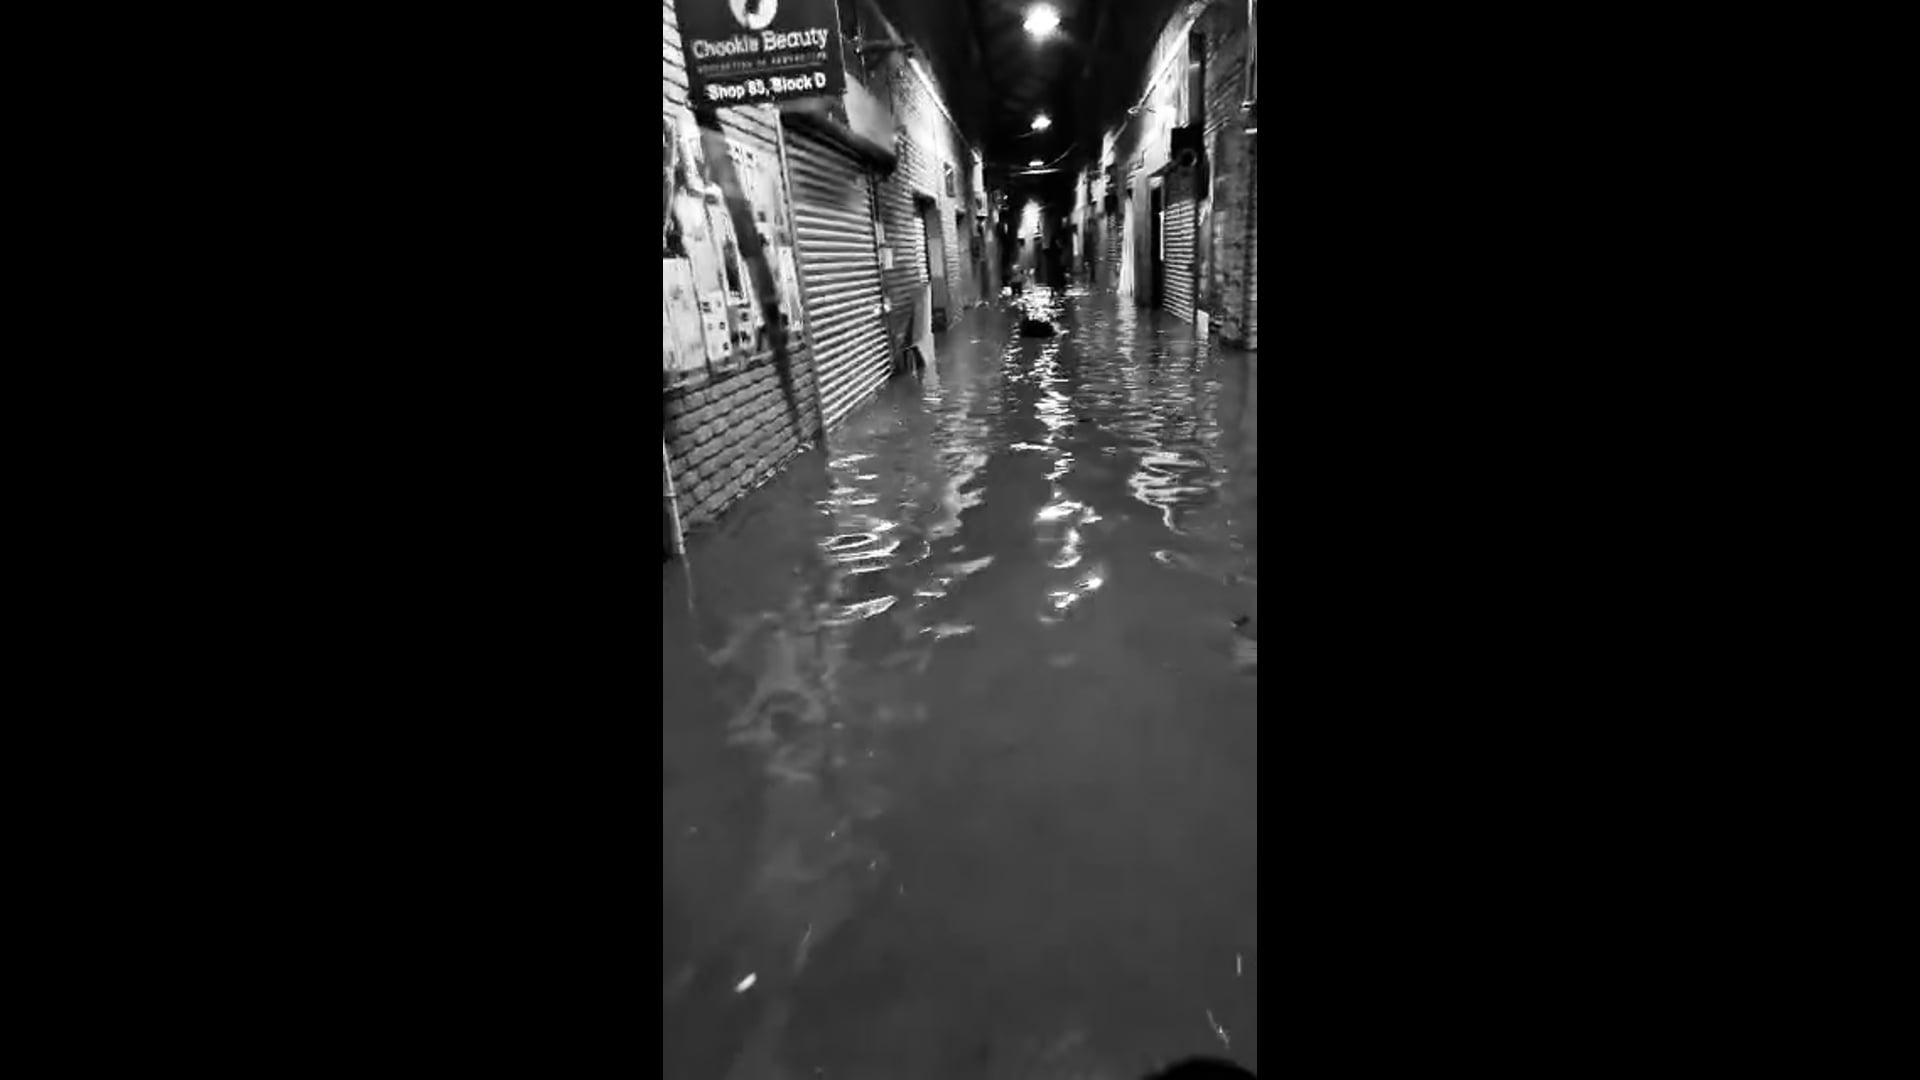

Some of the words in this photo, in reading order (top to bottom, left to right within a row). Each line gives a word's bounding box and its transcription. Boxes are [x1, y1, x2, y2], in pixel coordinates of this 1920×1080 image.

[761, 28, 828, 51] Beauty
[705, 84, 745, 100] Shop
[770, 75, 812, 92] Block
[814, 72, 826, 87] D
